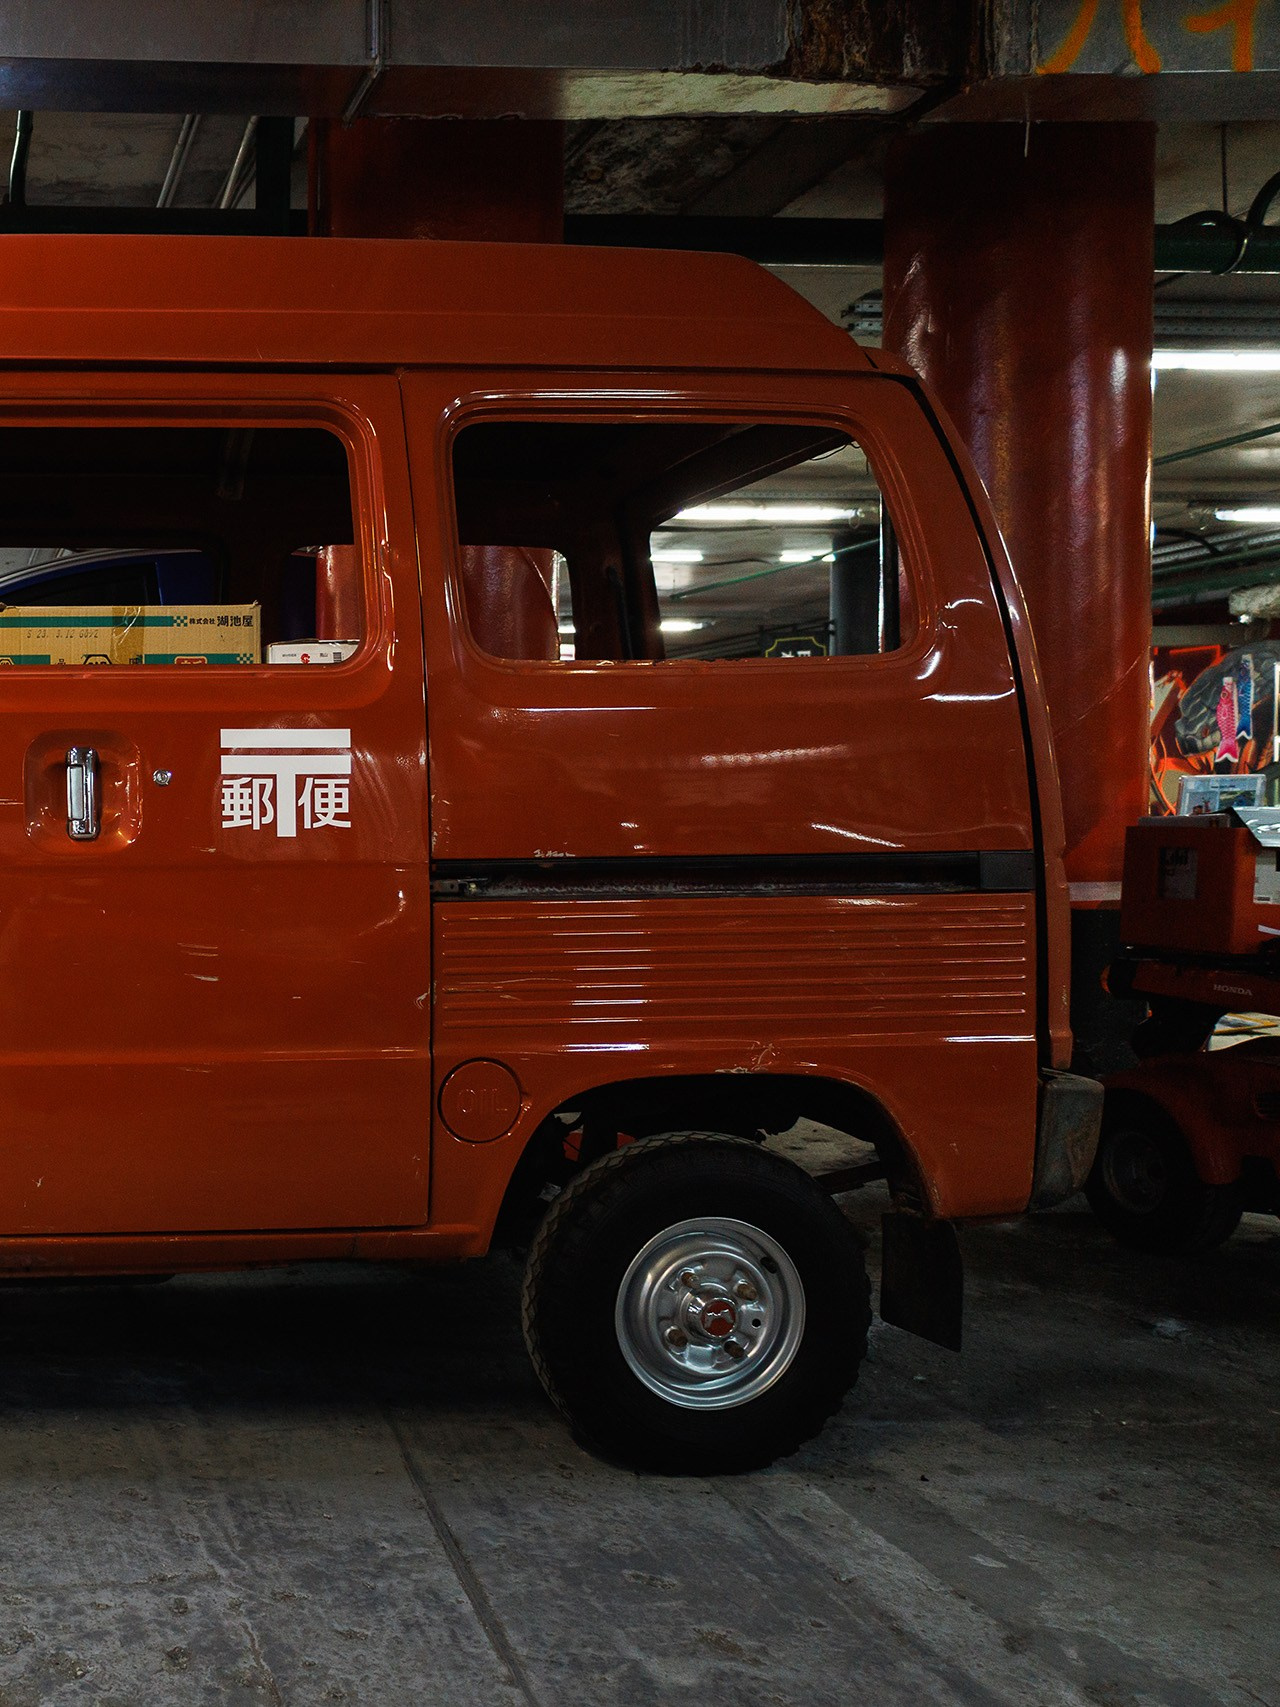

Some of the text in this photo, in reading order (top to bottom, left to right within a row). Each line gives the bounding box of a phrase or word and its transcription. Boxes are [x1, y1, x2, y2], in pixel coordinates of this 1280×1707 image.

[217, 615, 254, 627] 湖池屋
[1213, 984, 1253, 996] HONDA
